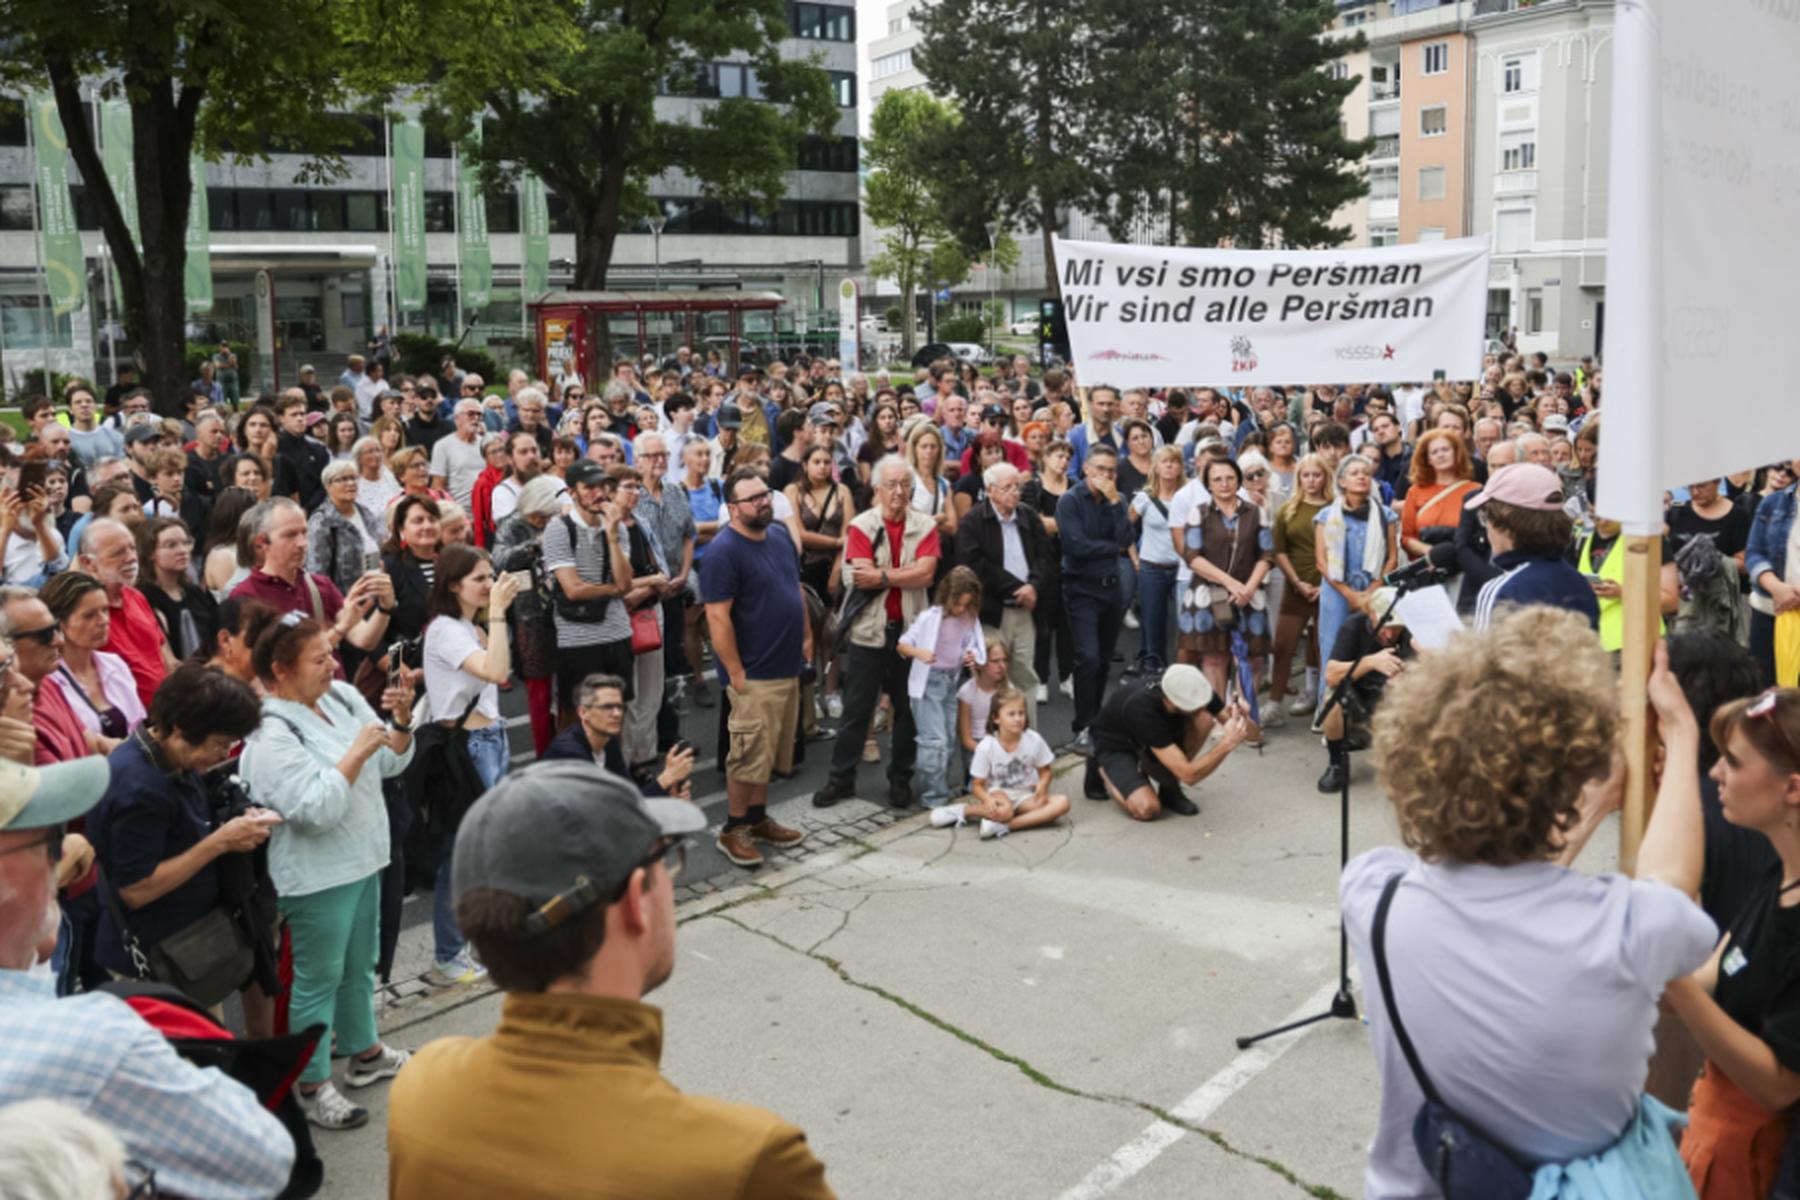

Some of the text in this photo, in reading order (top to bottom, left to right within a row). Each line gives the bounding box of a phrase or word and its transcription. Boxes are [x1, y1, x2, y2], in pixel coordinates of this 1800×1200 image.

[1064, 258, 1422, 287] Mi vsi smo Peršman
[1119, 295, 1195, 322] sind
[1204, 295, 1268, 322] alle
[1280, 292, 1434, 322] Peršman
